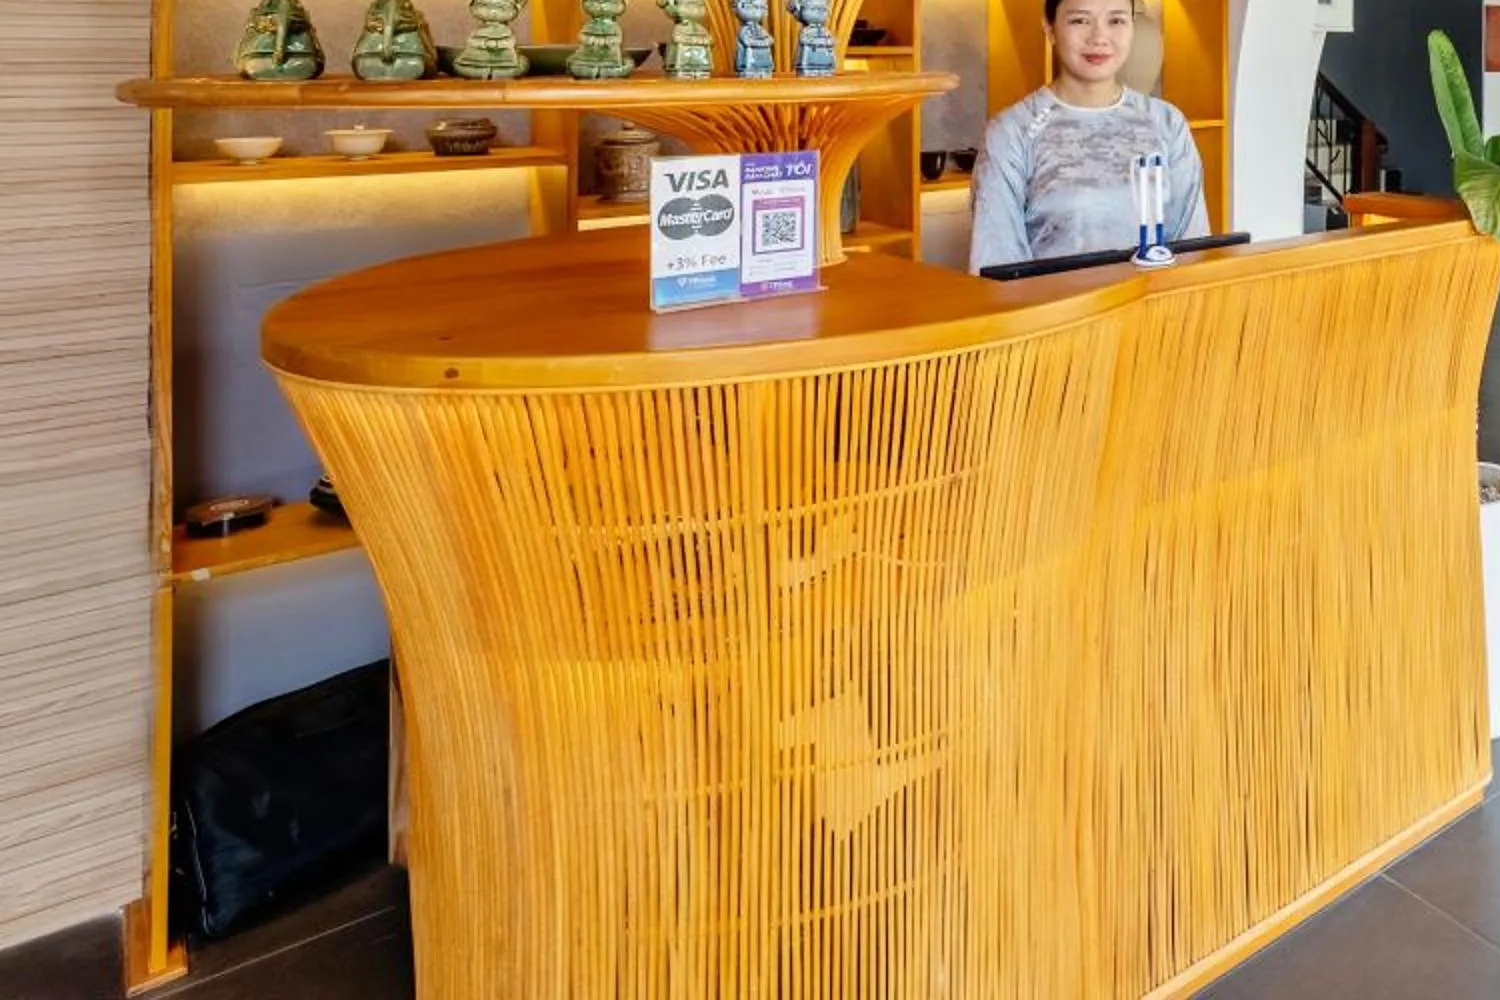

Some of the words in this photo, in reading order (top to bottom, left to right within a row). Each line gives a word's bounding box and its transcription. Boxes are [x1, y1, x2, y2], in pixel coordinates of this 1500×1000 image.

[664, 168, 729, 192] VISA
[659, 207, 733, 227] MasterCard
[701, 253, 727, 266] Fee
